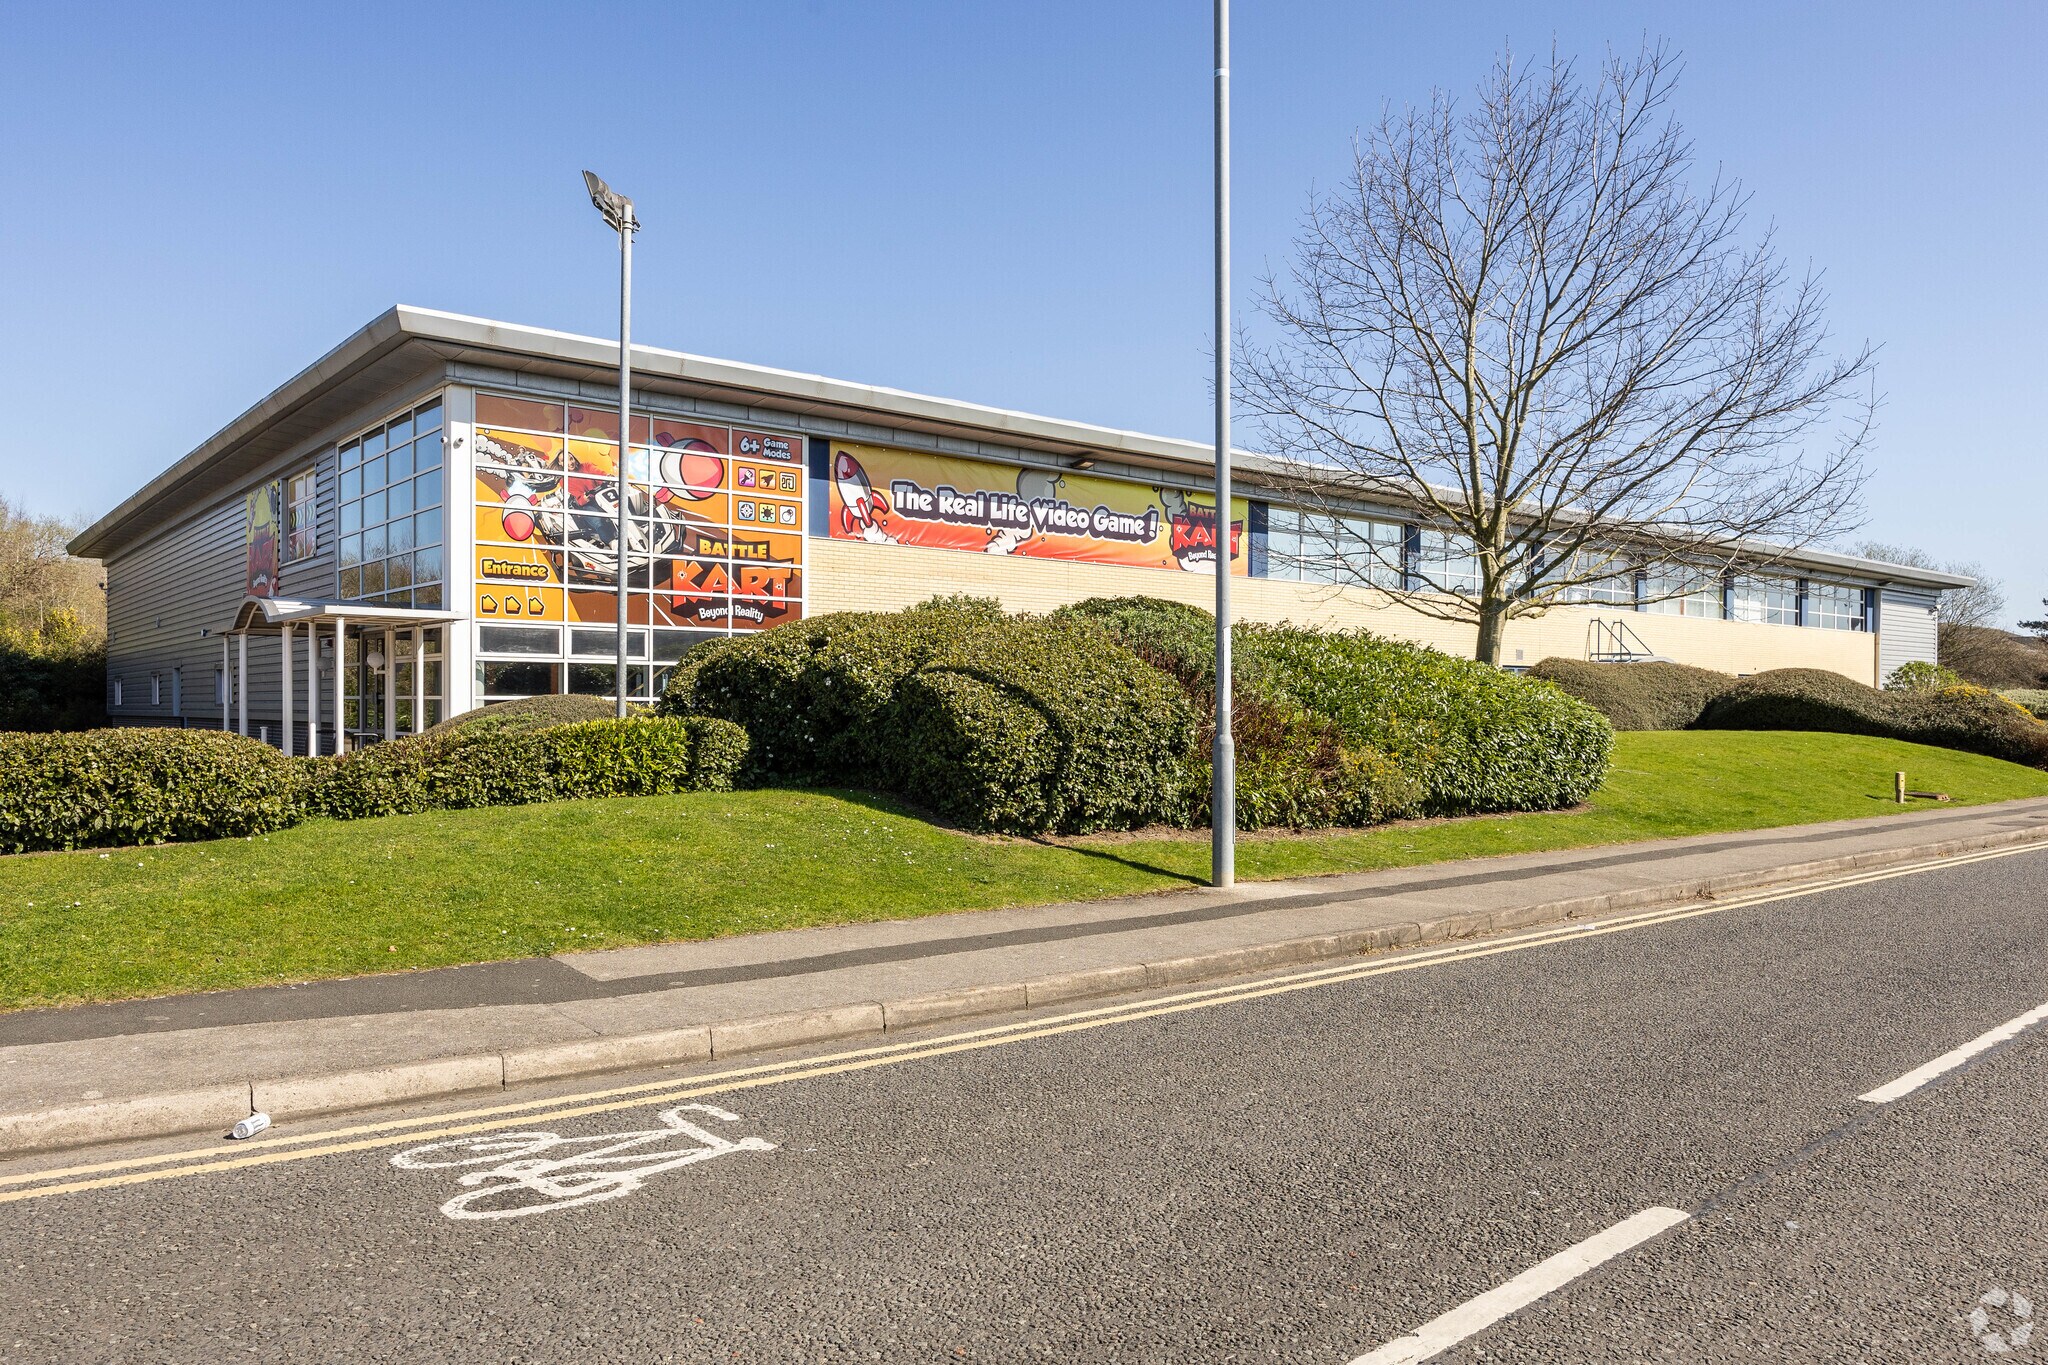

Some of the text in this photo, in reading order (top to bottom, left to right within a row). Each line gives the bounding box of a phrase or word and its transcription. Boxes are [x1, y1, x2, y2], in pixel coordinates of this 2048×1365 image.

[740, 437, 789, 452] 6+ Game
[763, 447, 791, 460] Modes
[607, 492, 616, 500] 2
[894, 484, 933, 512] The
[939, 490, 984, 518] Real
[990, 496, 1029, 522] Life
[1032, 500, 1090, 529] Video
[1190, 504, 1216, 519] BATT
[1173, 516, 1242, 555] KAT
[699, 538, 767, 560] BATTLE
[1188, 550, 1208, 562] Beyond
[483, 560, 547, 577] Entrance
[672, 559, 792, 610] KART
[734, 605, 764, 623] Reality
